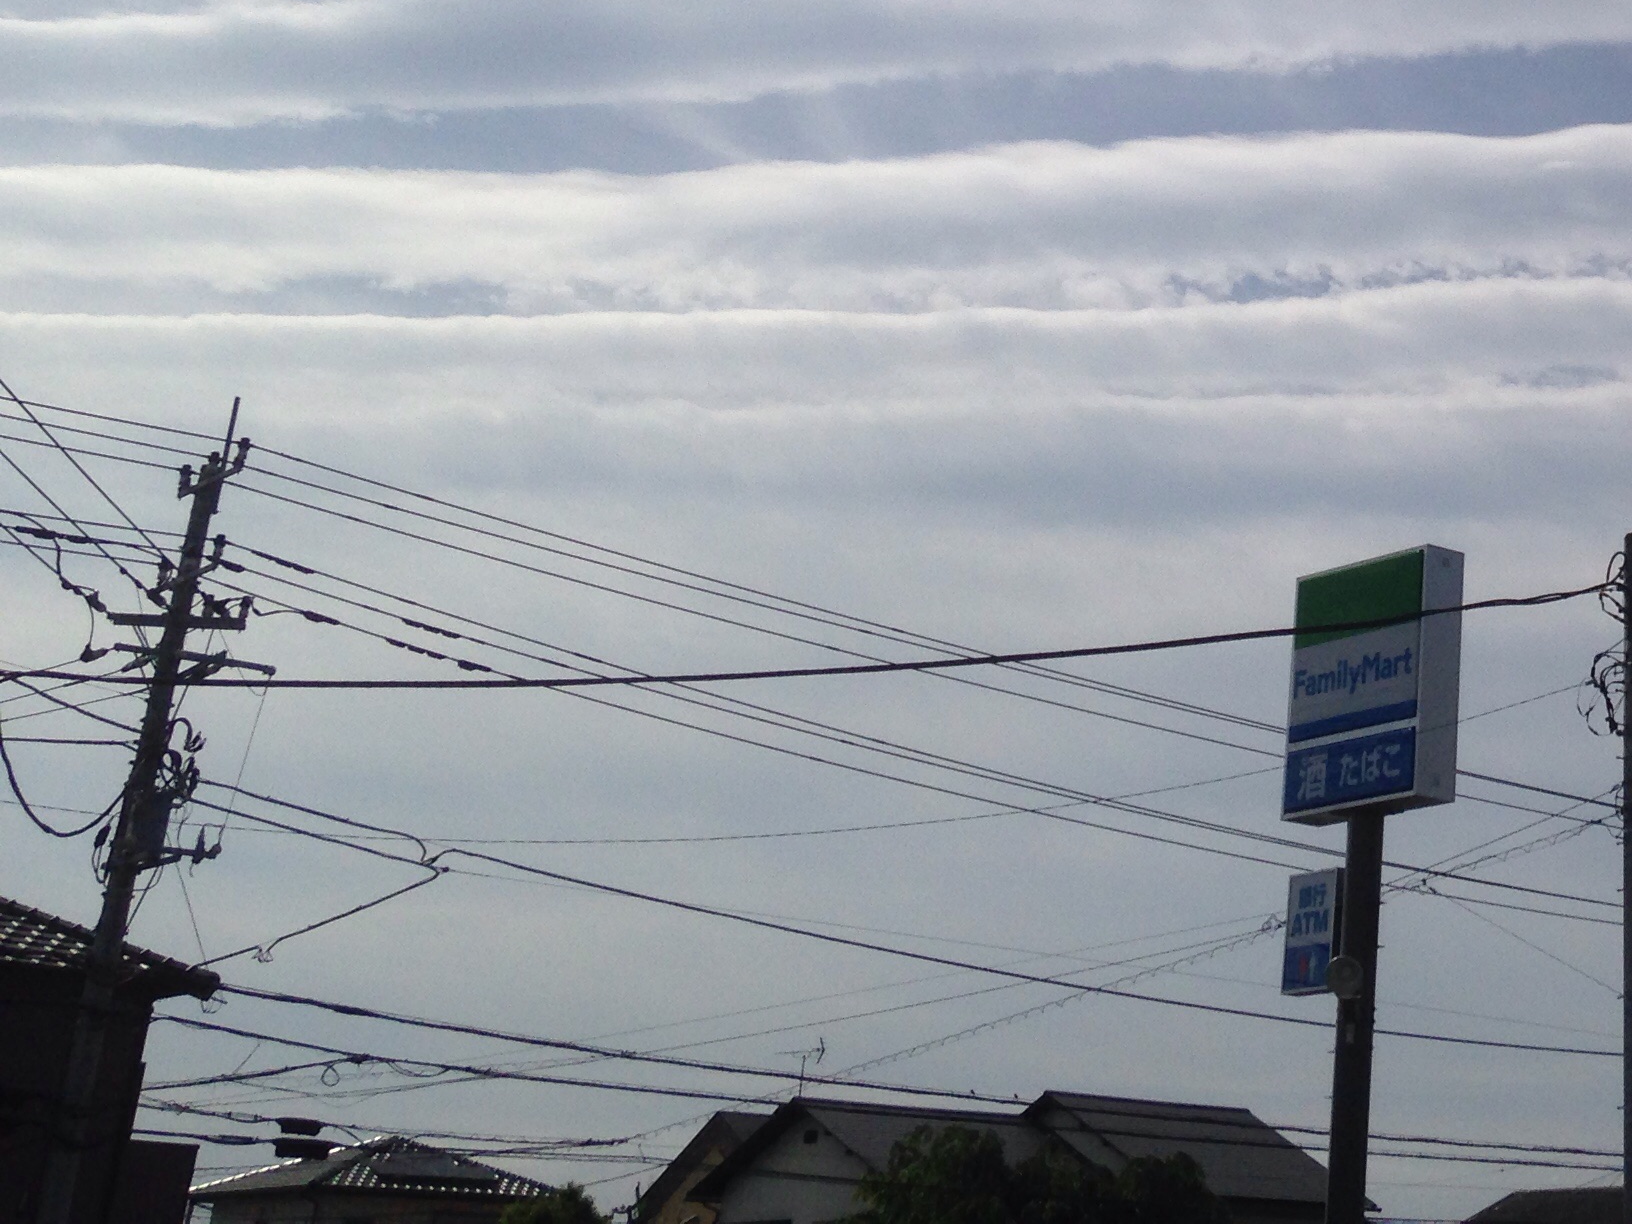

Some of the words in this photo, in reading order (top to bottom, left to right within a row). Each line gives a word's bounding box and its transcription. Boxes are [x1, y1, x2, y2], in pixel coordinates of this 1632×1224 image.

[1294, 647, 1412, 699] FamilyMart
[1297, 753, 1328, 801] 酒
[1339, 744, 1401, 786] たばこ
[1290, 907, 1329, 937] ATM
